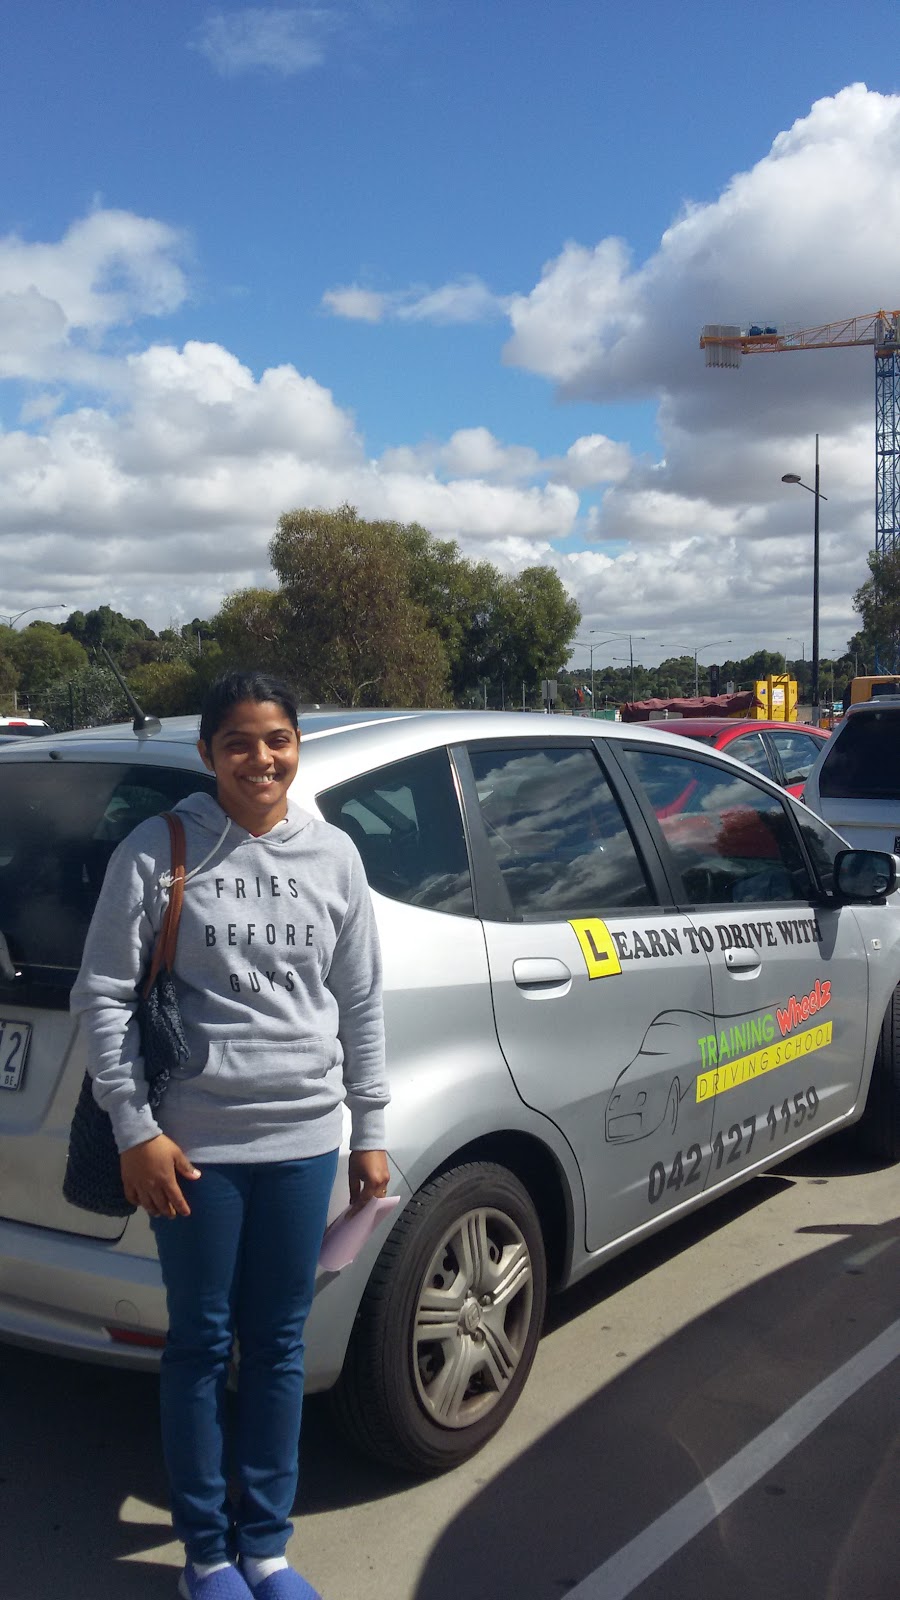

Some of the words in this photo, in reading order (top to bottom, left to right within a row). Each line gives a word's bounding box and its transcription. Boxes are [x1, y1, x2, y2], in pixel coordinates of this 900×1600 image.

[215, 876, 298, 898] FRIES
[205, 923, 314, 947] BEFORE
[683, 926, 714, 953] TO
[715, 922, 777, 950] DRIVE
[776, 918, 823, 945] WITH
[229, 970, 294, 992] GUYS
[698, 1014, 775, 1068] TRAINING
[776, 979, 832, 1037] Wheelz
[0, 1030, 21, 1073] 2
[699, 1051, 769, 1100] DRIVING
[775, 1026, 832, 1065] SCHOOL
[648, 1143, 703, 1205] 042
[711, 1115, 757, 1170] 127
[767, 1085, 820, 1141] 1159
